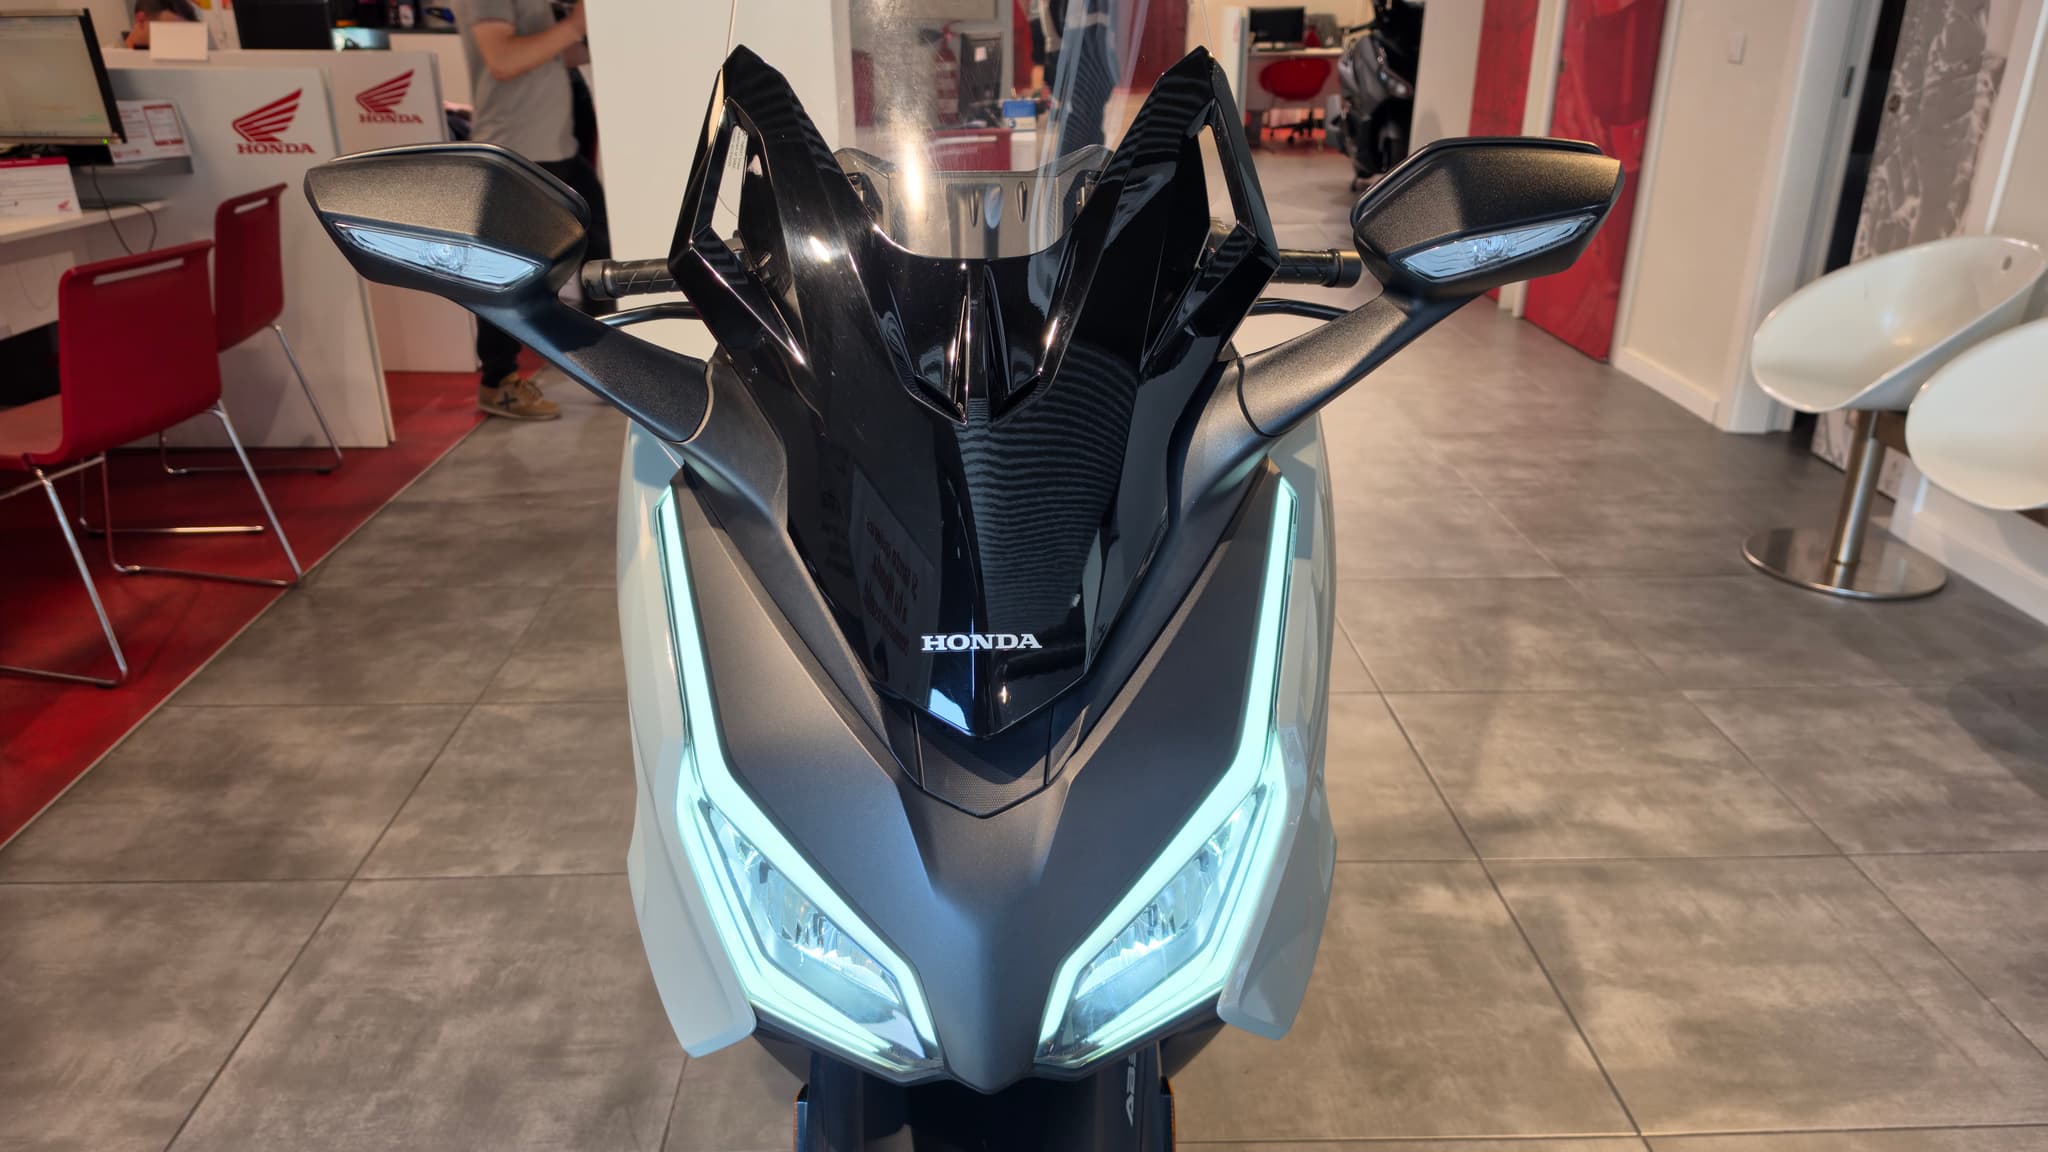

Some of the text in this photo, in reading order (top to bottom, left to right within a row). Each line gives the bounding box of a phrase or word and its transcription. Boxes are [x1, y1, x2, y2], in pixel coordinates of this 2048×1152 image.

[359, 113, 424, 125] HONDA
[236, 142, 317, 155] HONDA
[921, 633, 1043, 651] HONDA
